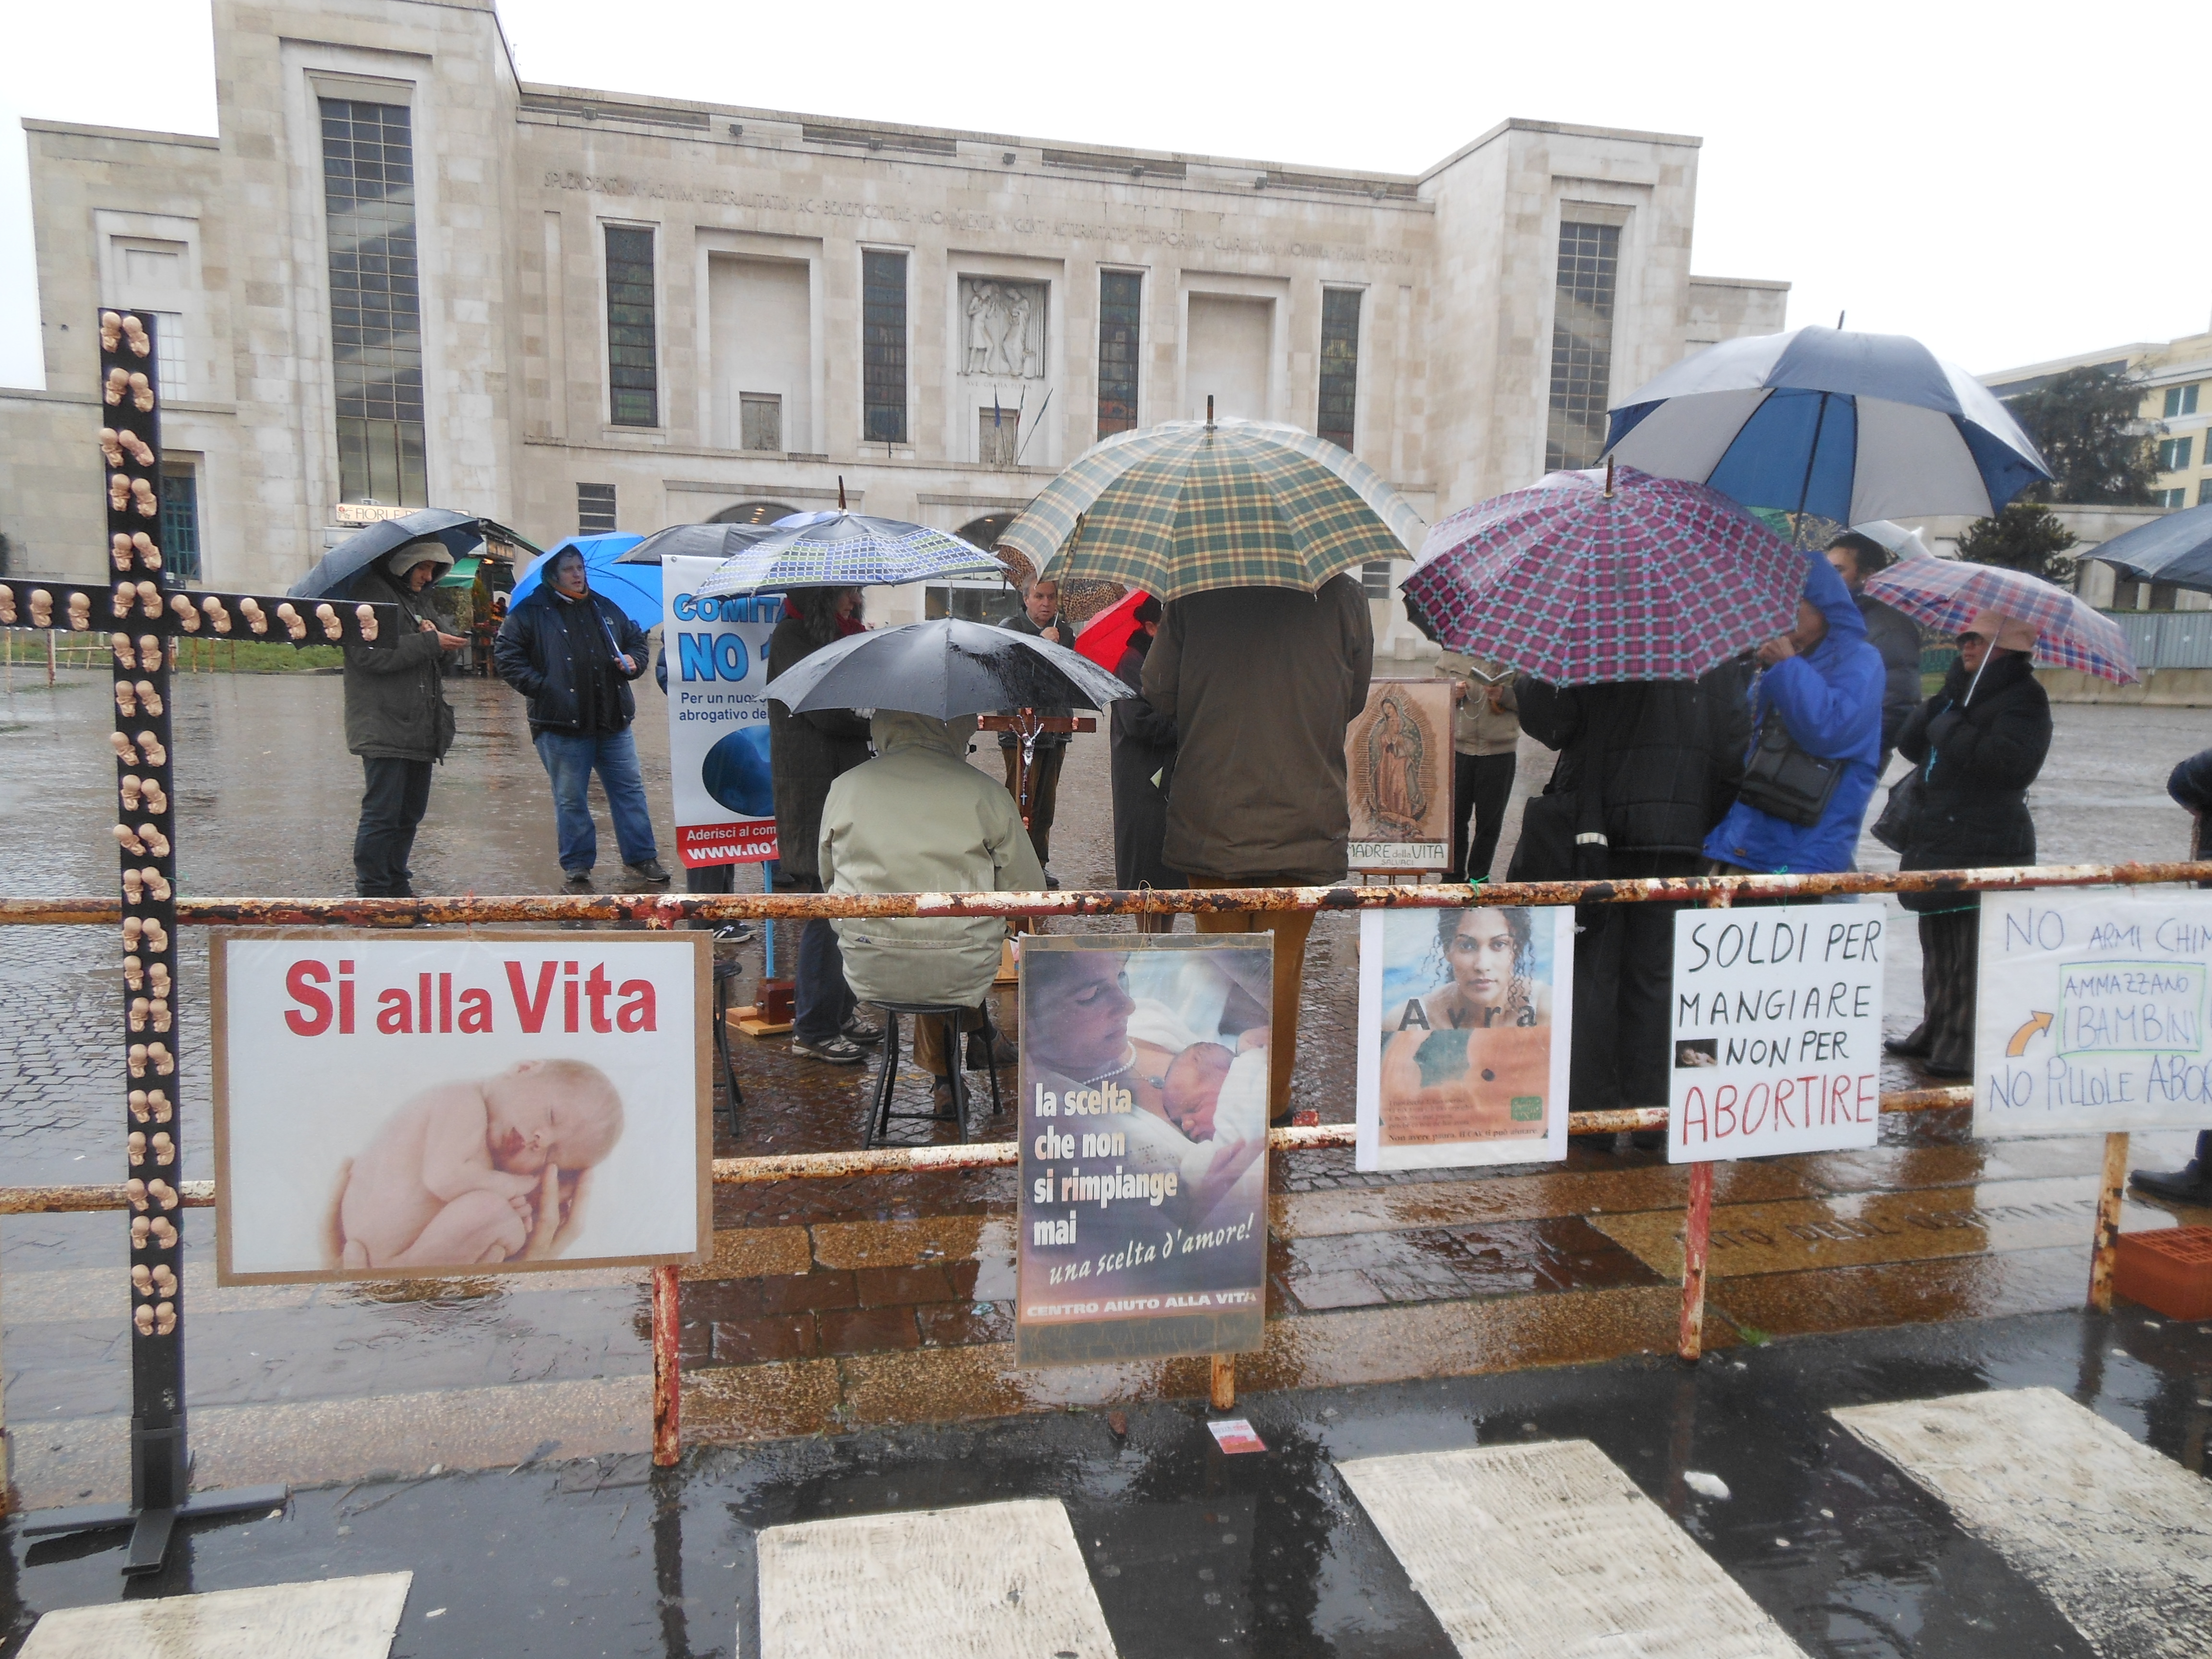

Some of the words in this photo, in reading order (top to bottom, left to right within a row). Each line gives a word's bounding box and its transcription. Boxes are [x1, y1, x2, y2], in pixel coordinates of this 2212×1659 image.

[797, 198, 815, 214] AC
[678, 632, 749, 682] NO
[679, 708, 748, 723] abrogativo
[681, 692, 703, 704] Per
[707, 694, 723, 704] un
[686, 827, 736, 842] Aderisci
[739, 826, 749, 837] al
[1392, 849, 1412, 858] della
[1412, 844, 1444, 859] VITA
[1688, 921, 1808, 973] SOLDI
[1825, 920, 1882, 963] PER
[2006, 908, 2065, 951] NO
[2088, 922, 2141, 951] ARMI
[283, 959, 355, 1037] Si
[376, 972, 493, 1034] alla
[503, 960, 658, 1034] Vita
[1679, 981, 1871, 1027] MANGIARE
[2064, 972, 2189, 999] AMMAZZANO
[1398, 996, 1538, 1031] Avrà
[2063, 1008, 2068, 1048] I
[2077, 1004, 2200, 1048] BAMBINI
[1726, 1036, 1791, 1068] NON
[1800, 1030, 1850, 1062] PER
[1035, 1082, 1057, 1118] la
[1064, 1080, 1132, 1116] scelta
[1989, 1065, 2032, 1112] NO
[2047, 1056, 2134, 1111] PILLOLE
[1683, 1074, 1875, 1146] ABORTIRE
[1034, 1125, 1075, 1160] che
[1082, 1131, 1125, 1158] non
[1493, 1128, 1508, 1138] può
[1034, 1168, 1054, 1204] si
[1061, 1165, 1178, 1209] rimpiange
[1033, 1210, 1077, 1247] mai
[1050, 1262, 1091, 1286] una
[1096, 1241, 1156, 1277] scelta
[1162, 1212, 1255, 1259] d'amore!
[1027, 1302, 1099, 1318] CENTRO
[1104, 1298, 1160, 1313] AIUTO
[1165, 1295, 1212, 1309] ALLA
[1215, 1291, 1257, 1305] VITA
